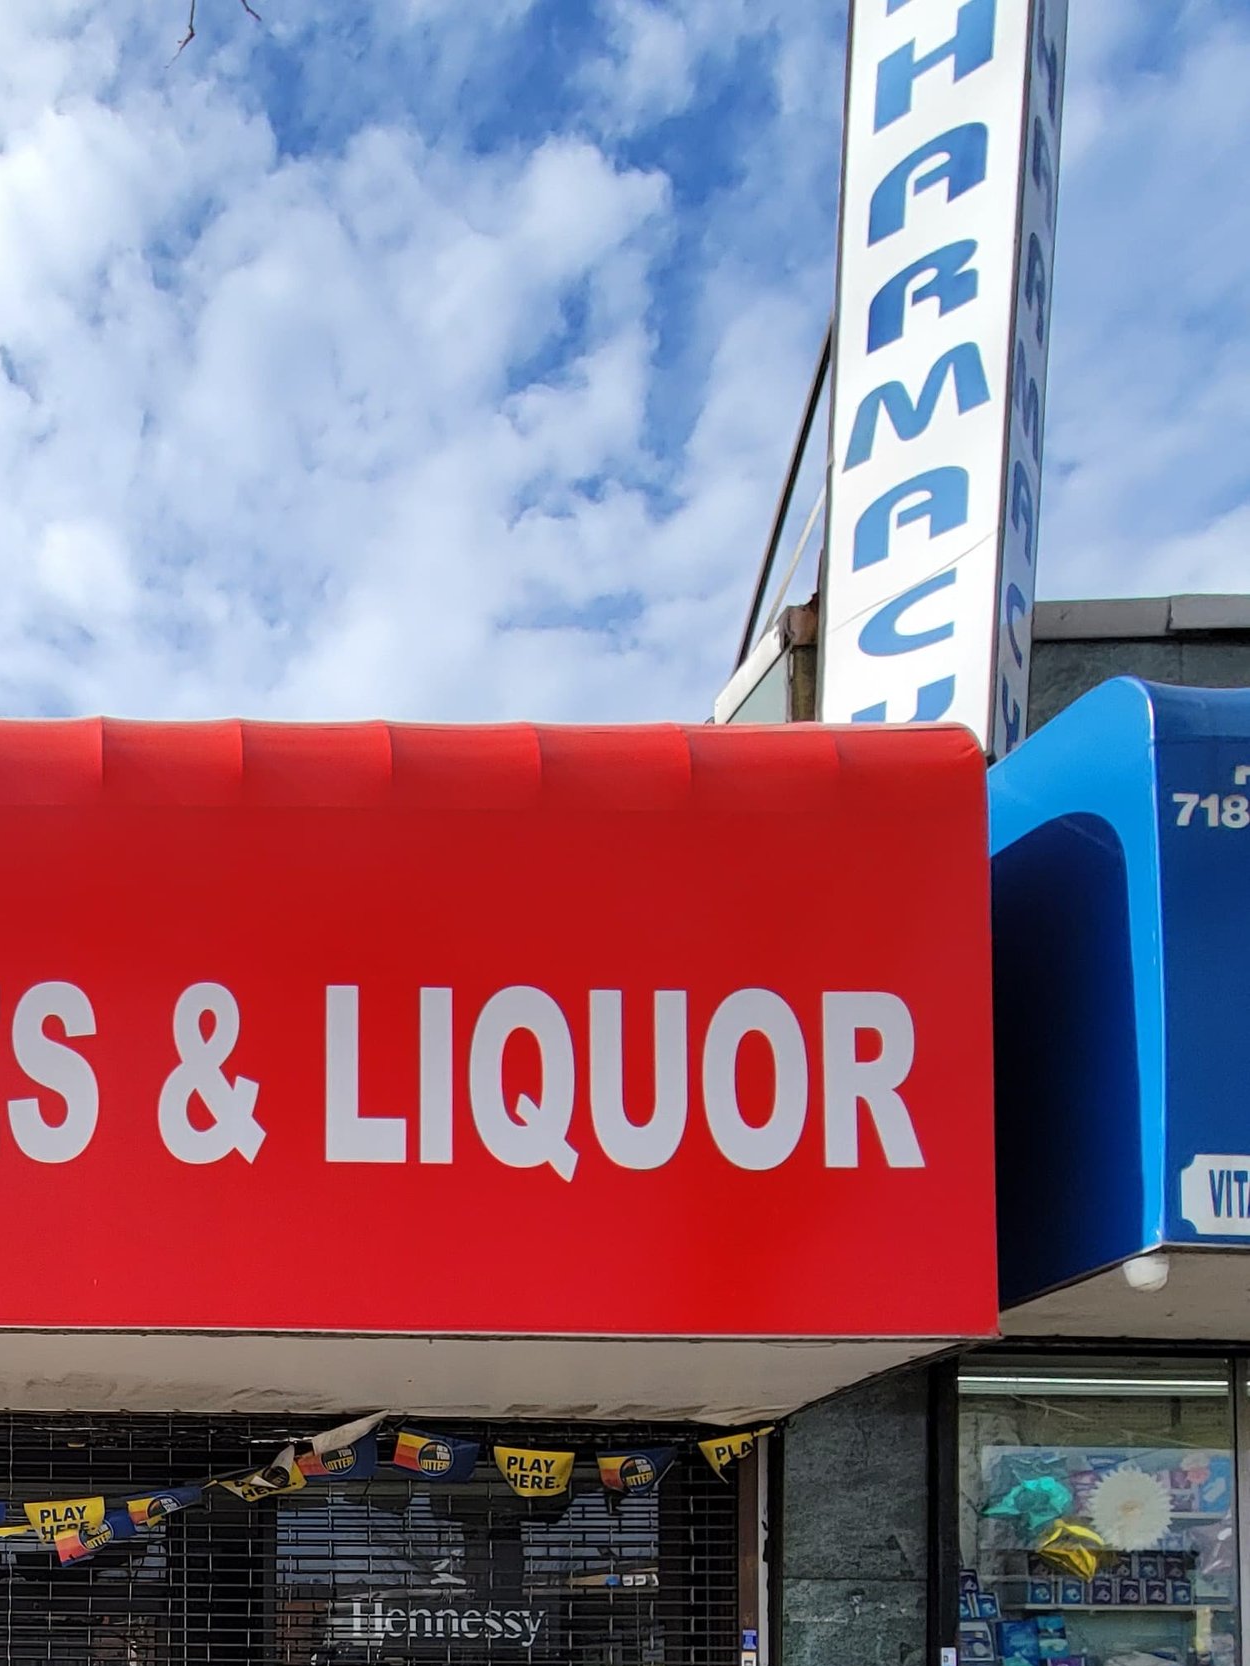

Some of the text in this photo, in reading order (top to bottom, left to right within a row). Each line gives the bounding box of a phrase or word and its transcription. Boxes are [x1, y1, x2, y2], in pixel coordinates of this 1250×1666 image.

[843, 0, 998, 724] HARMAC
[159, 983, 266, 1165] &
[326, 986, 925, 1183] LIQUOR
[1209, 1169, 1250, 1218] VIT
[507, 1456, 556, 1473] PLAY
[714, 1442, 753, 1460] PLA
[40, 1505, 87, 1523] PLAY
[352, 1598, 546, 1647] Hennessy
